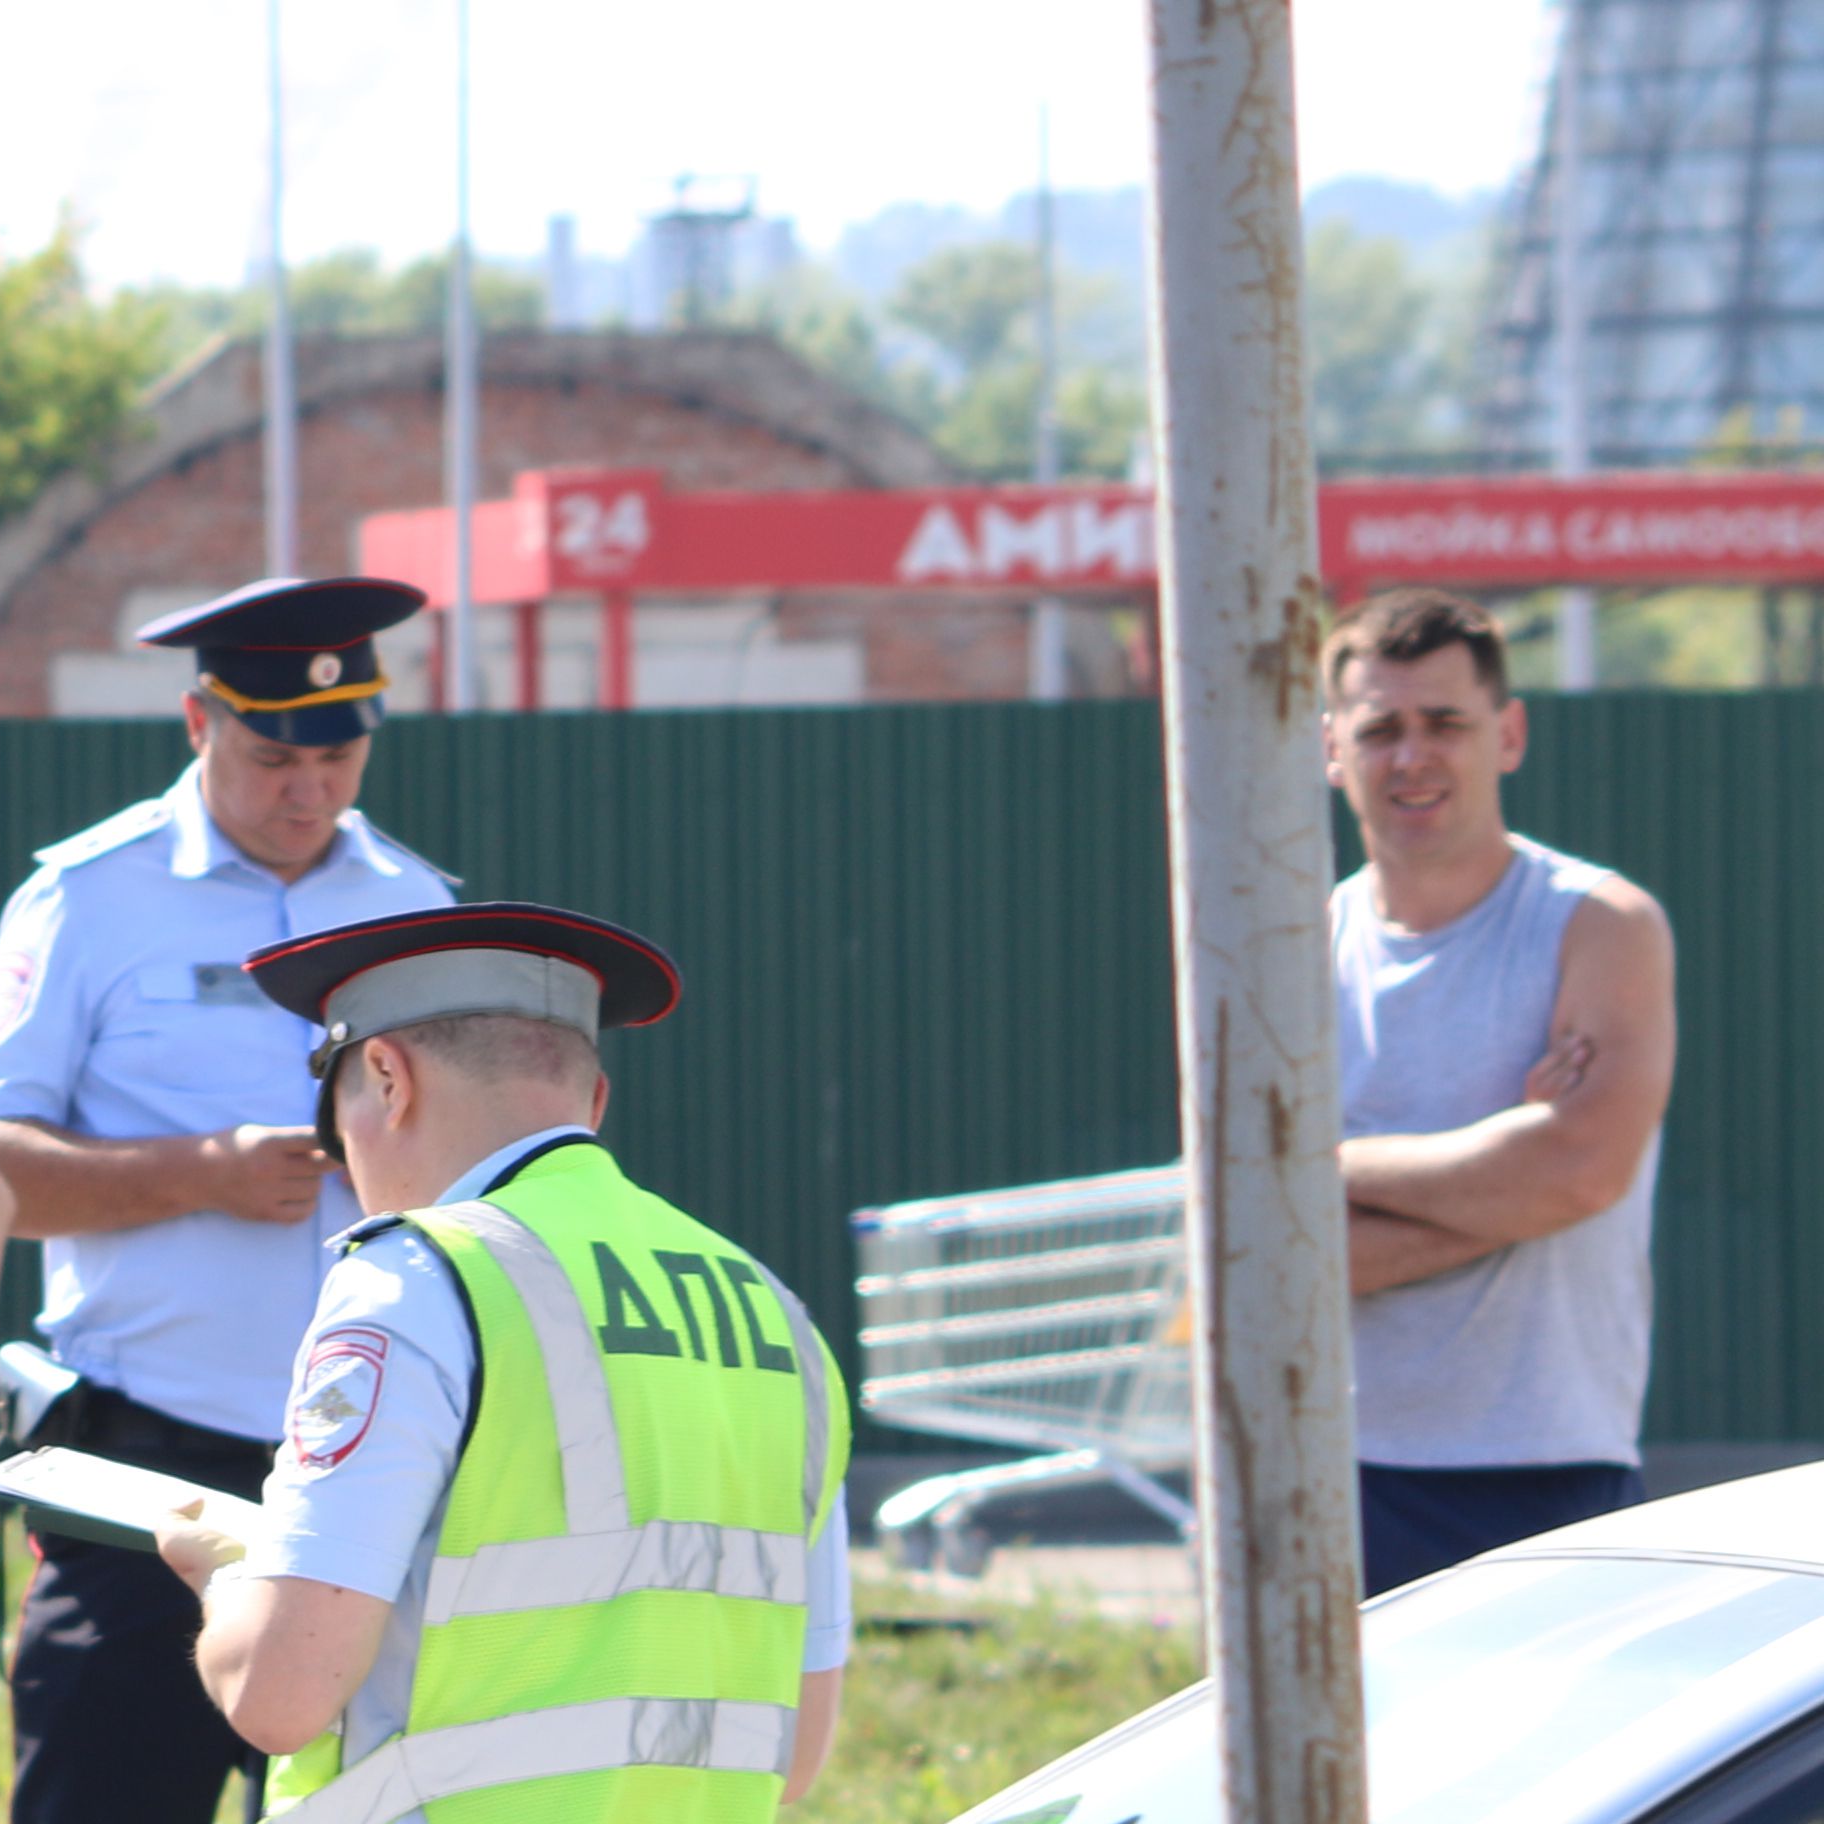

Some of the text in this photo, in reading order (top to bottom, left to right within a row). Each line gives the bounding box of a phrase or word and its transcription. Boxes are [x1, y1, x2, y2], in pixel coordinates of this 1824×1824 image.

[555, 492, 650, 555] 24
[1346, 503, 1554, 564] МОЙКА
[589, 1240, 797, 1375] ДПС
